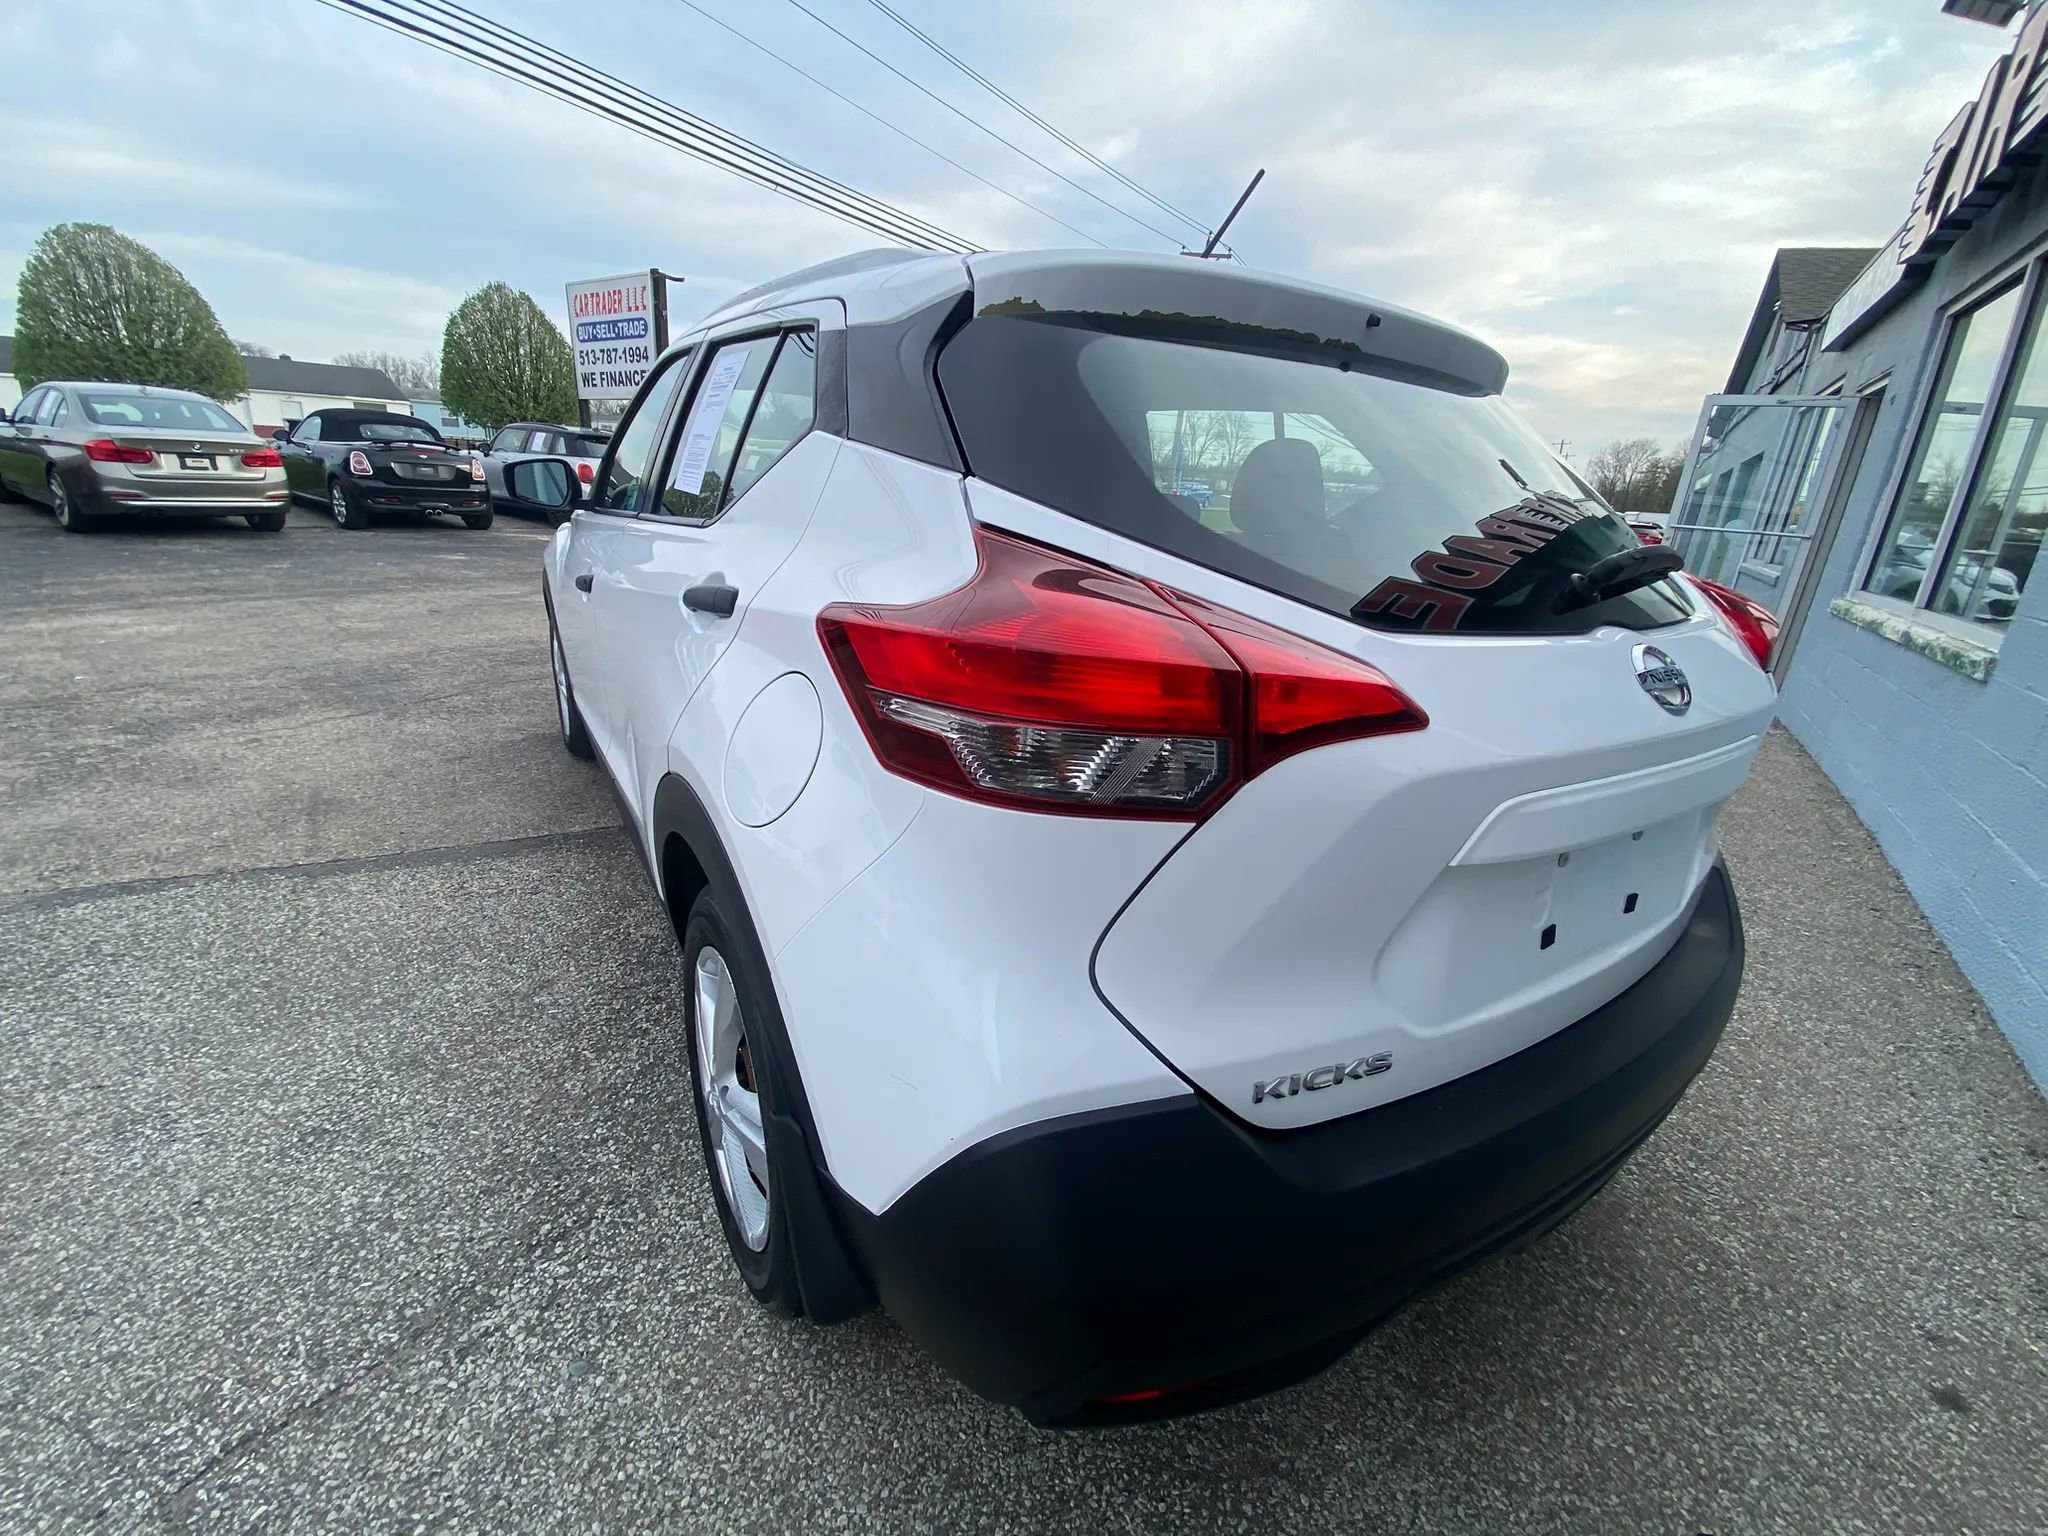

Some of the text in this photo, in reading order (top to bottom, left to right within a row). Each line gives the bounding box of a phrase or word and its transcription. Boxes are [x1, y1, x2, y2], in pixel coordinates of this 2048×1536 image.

[625, 285, 647, 313] LLC
[579, 345, 649, 366] 513-787-1994
[581, 371, 598, 388] WE
[1252, 1051, 1392, 1104] KICKS
